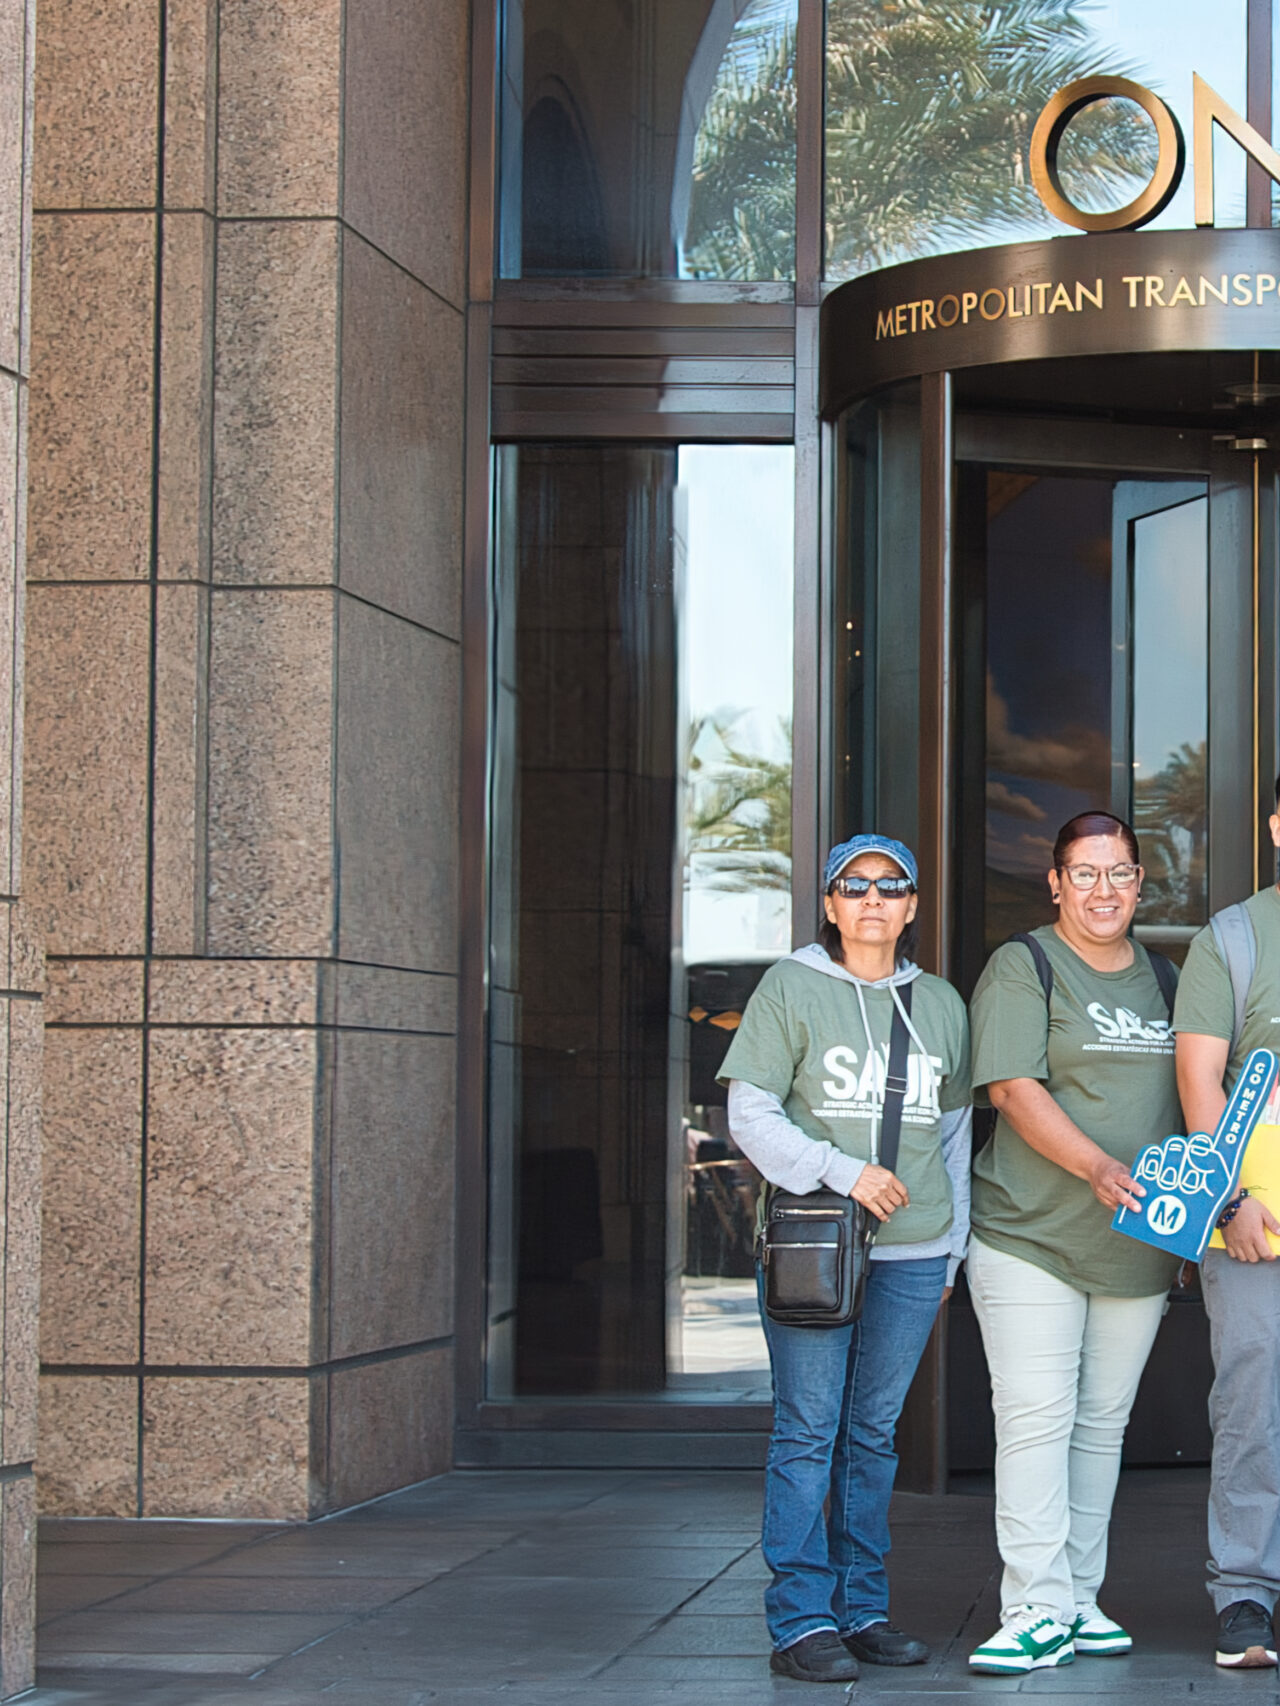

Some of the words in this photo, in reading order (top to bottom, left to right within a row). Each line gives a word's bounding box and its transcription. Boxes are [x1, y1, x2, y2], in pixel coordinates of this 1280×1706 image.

[875, 278, 1103, 341] METROPOLITAN
[1249, 1062, 1266, 1085] GO
[1225, 1087, 1256, 1145] METRO
[1152, 1200, 1181, 1230] M
